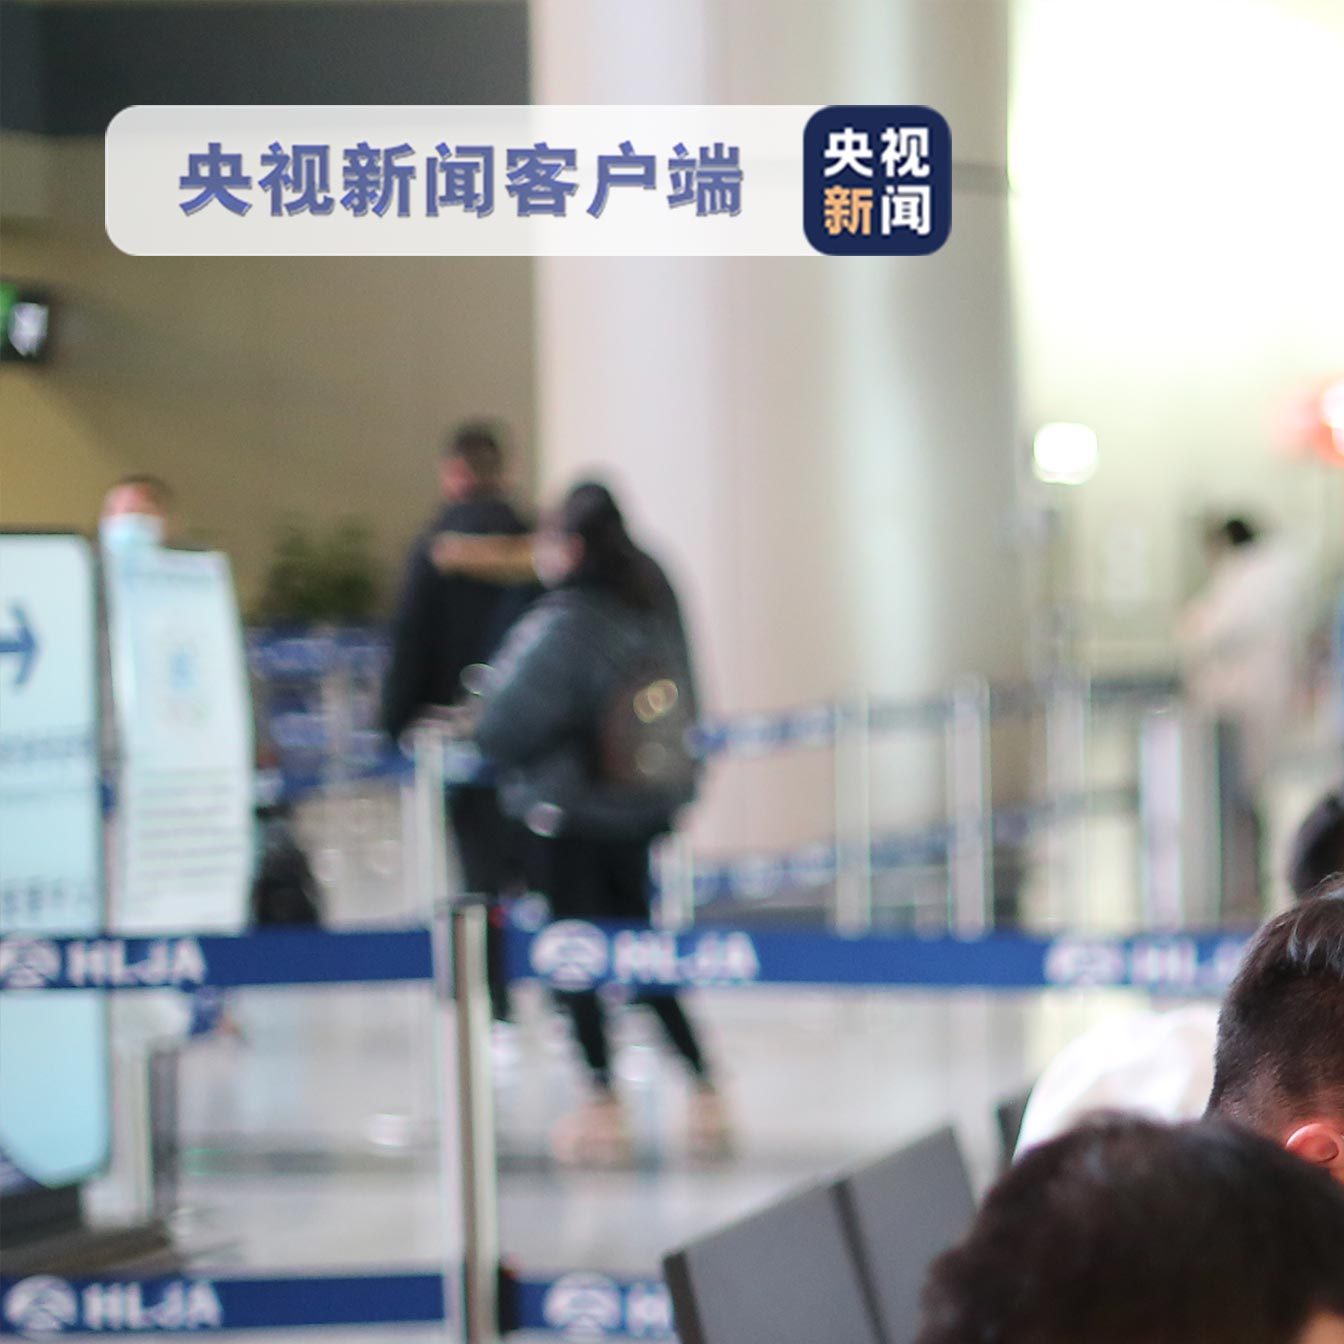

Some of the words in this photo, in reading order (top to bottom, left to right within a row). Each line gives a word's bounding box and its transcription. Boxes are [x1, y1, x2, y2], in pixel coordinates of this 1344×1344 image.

[66, 938, 207, 987] HLJA
[613, 929, 760, 985] HLJA
[1131, 937, 1246, 991] HLJ
[82, 1281, 222, 1330] HLJA
